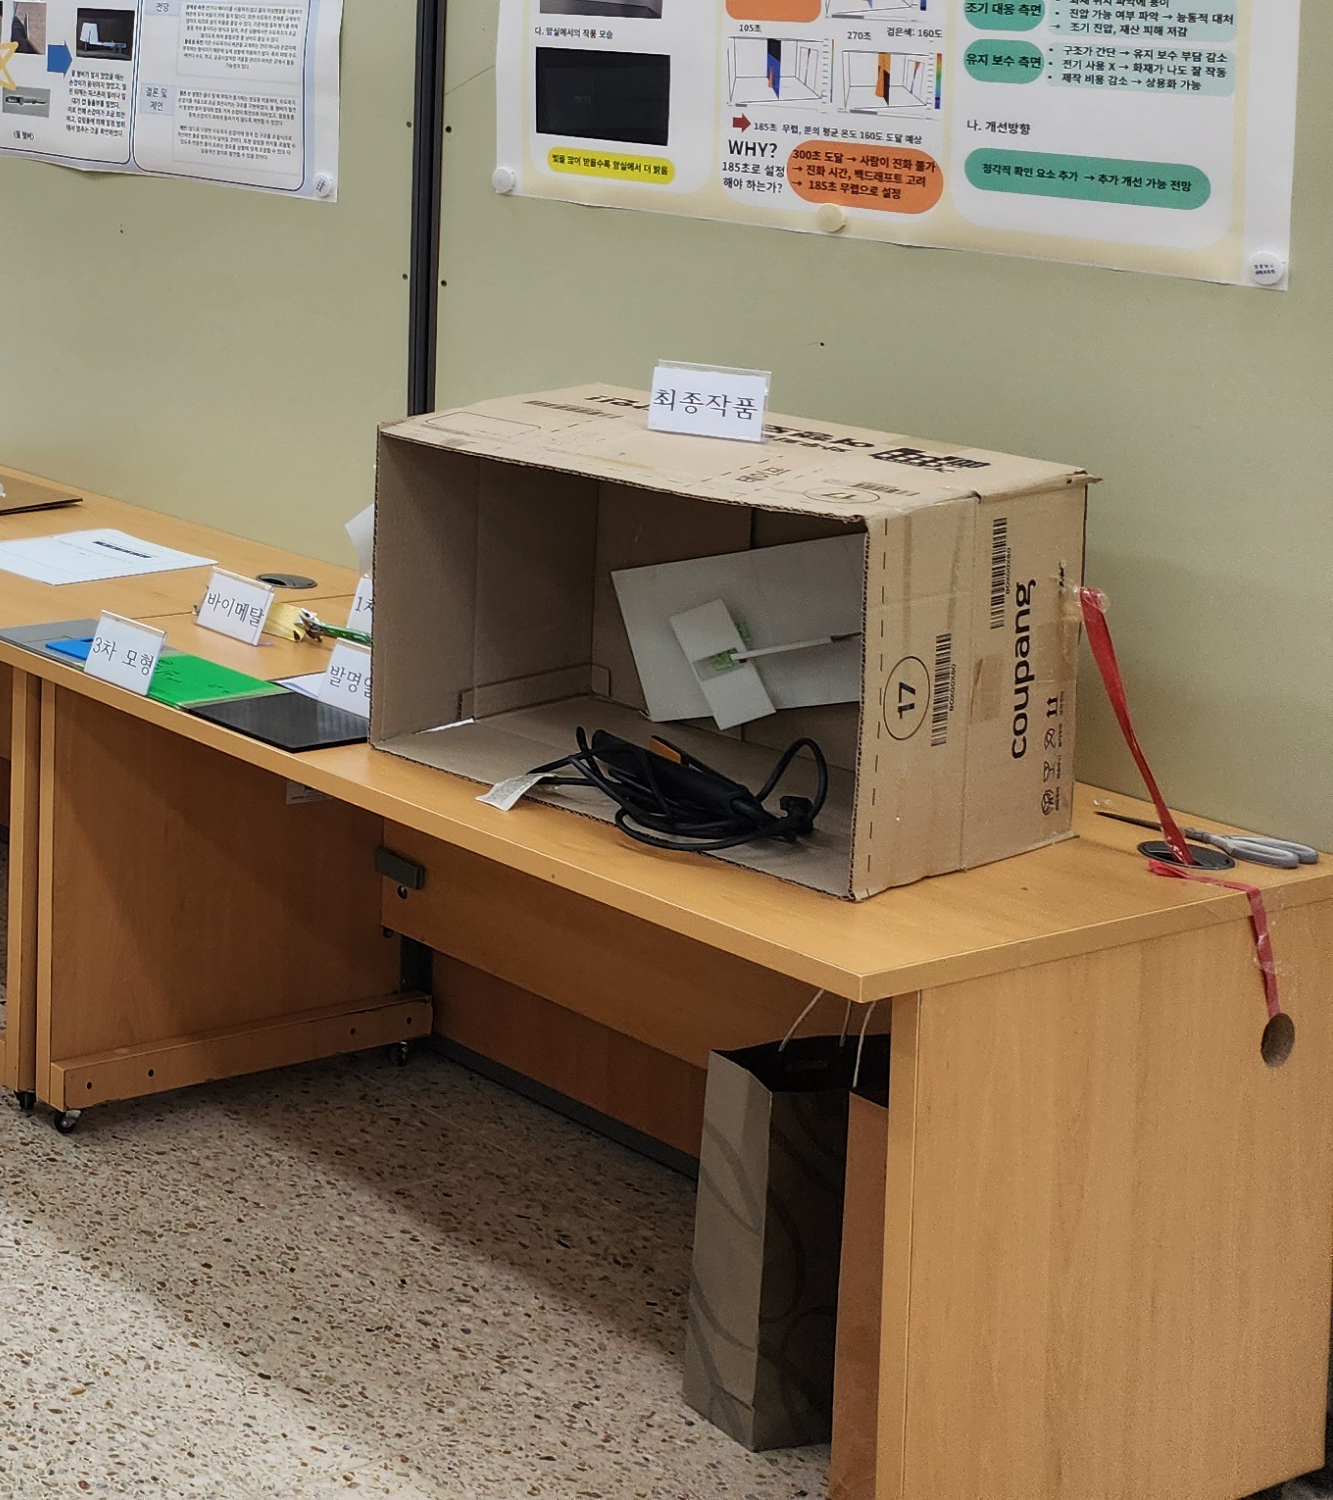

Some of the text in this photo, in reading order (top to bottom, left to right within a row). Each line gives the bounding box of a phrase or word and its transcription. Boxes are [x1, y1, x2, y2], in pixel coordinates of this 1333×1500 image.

[965, 1, 1041, 16] 조기 대응 측면
[965, 53, 1041, 69] 유지 보수 측면
[966, 119, 1030, 135] 나. 개선방향
[728, 139, 778, 159] WHY?
[721, 161, 785, 178] 185초로 설정
[653, 388, 759, 421] 최종작품
[207, 592, 265, 628] 바이메탈
[92, 636, 155, 676] 3차 모형
[1011, 579, 1037, 760] coupang
[897, 681, 916, 719] 17
